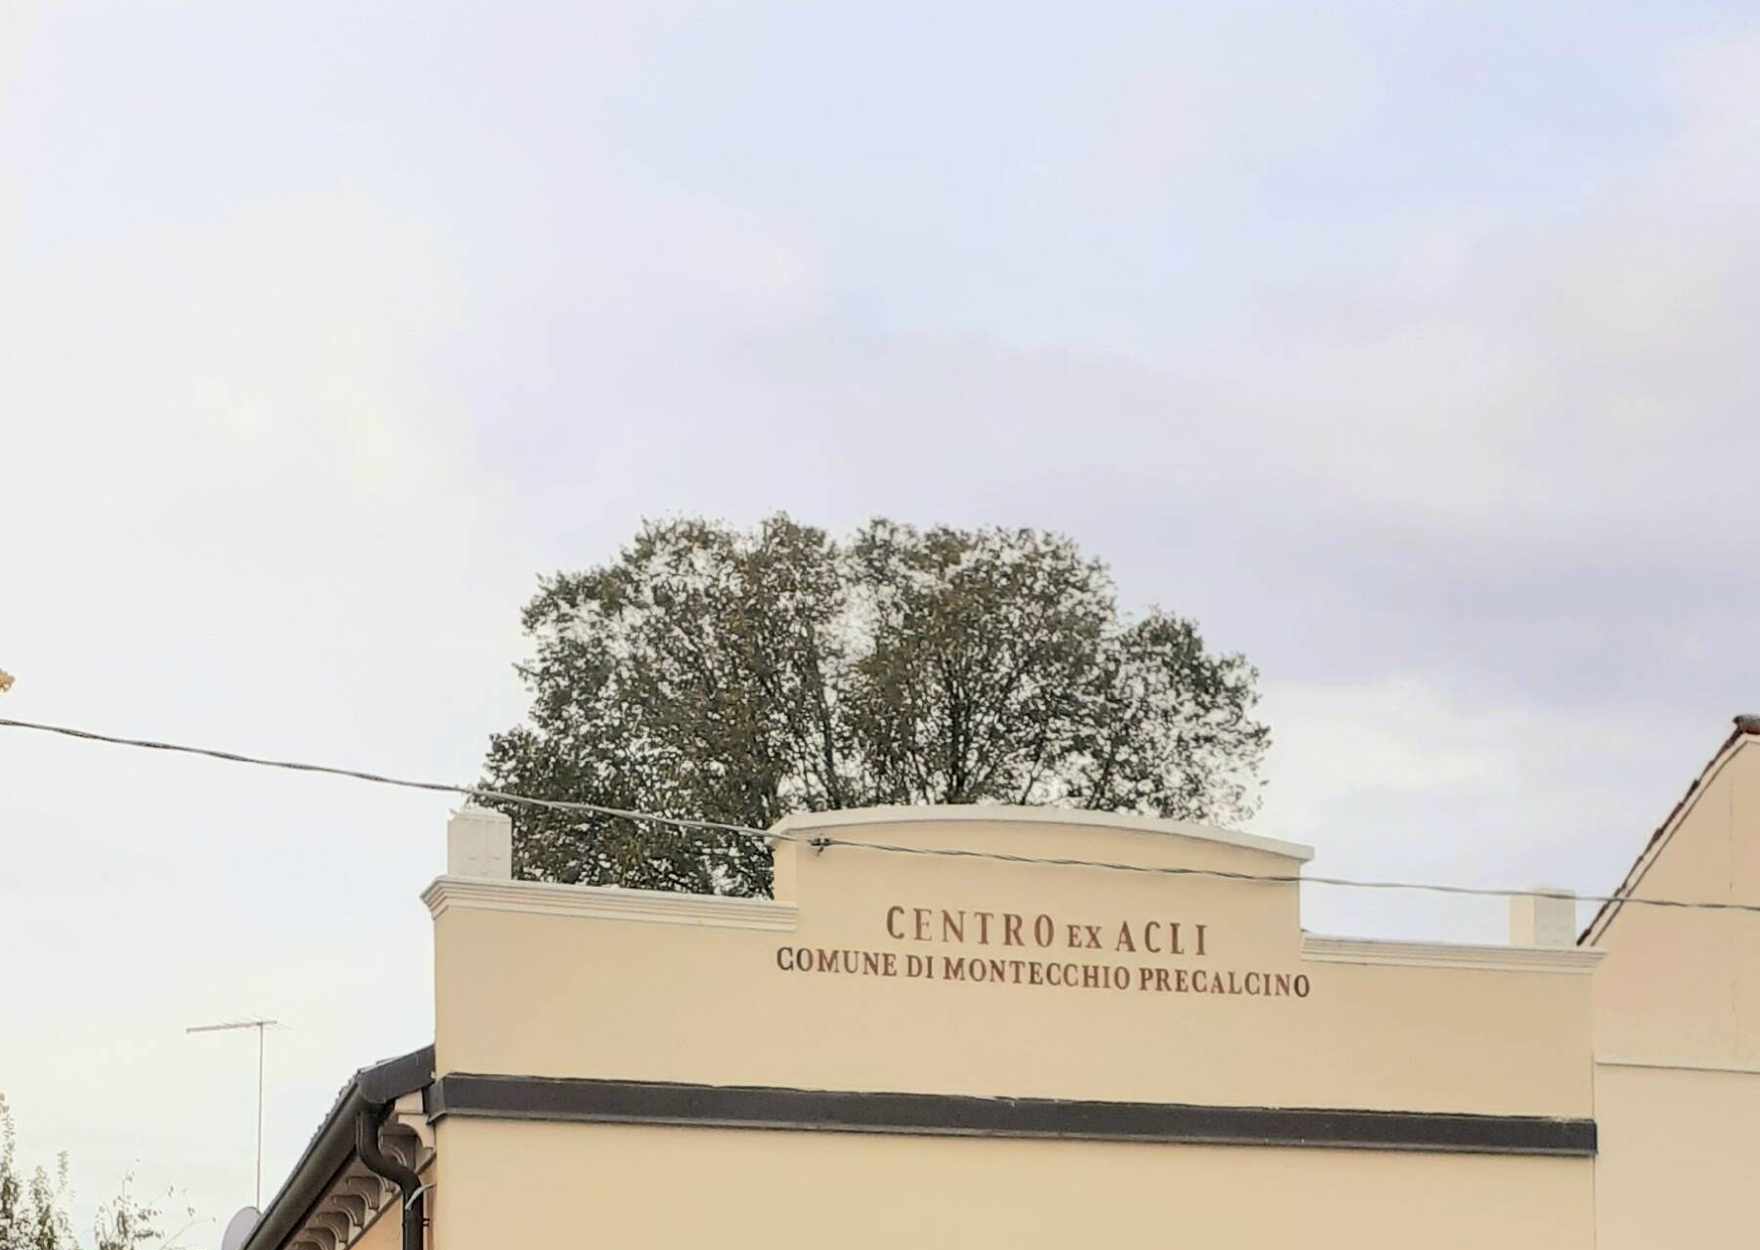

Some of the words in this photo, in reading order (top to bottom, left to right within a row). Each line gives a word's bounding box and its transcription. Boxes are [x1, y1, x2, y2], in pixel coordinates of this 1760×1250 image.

[886, 905, 1055, 948] CENTRO
[1067, 924, 1102, 948] EX
[1115, 920, 1208, 956] ACLI
[776, 946, 898, 976] COMUNE
[906, 954, 934, 979] DI
[943, 956, 1131, 990] MONTECCHIO
[1139, 967, 1310, 998] PRECALCINO
